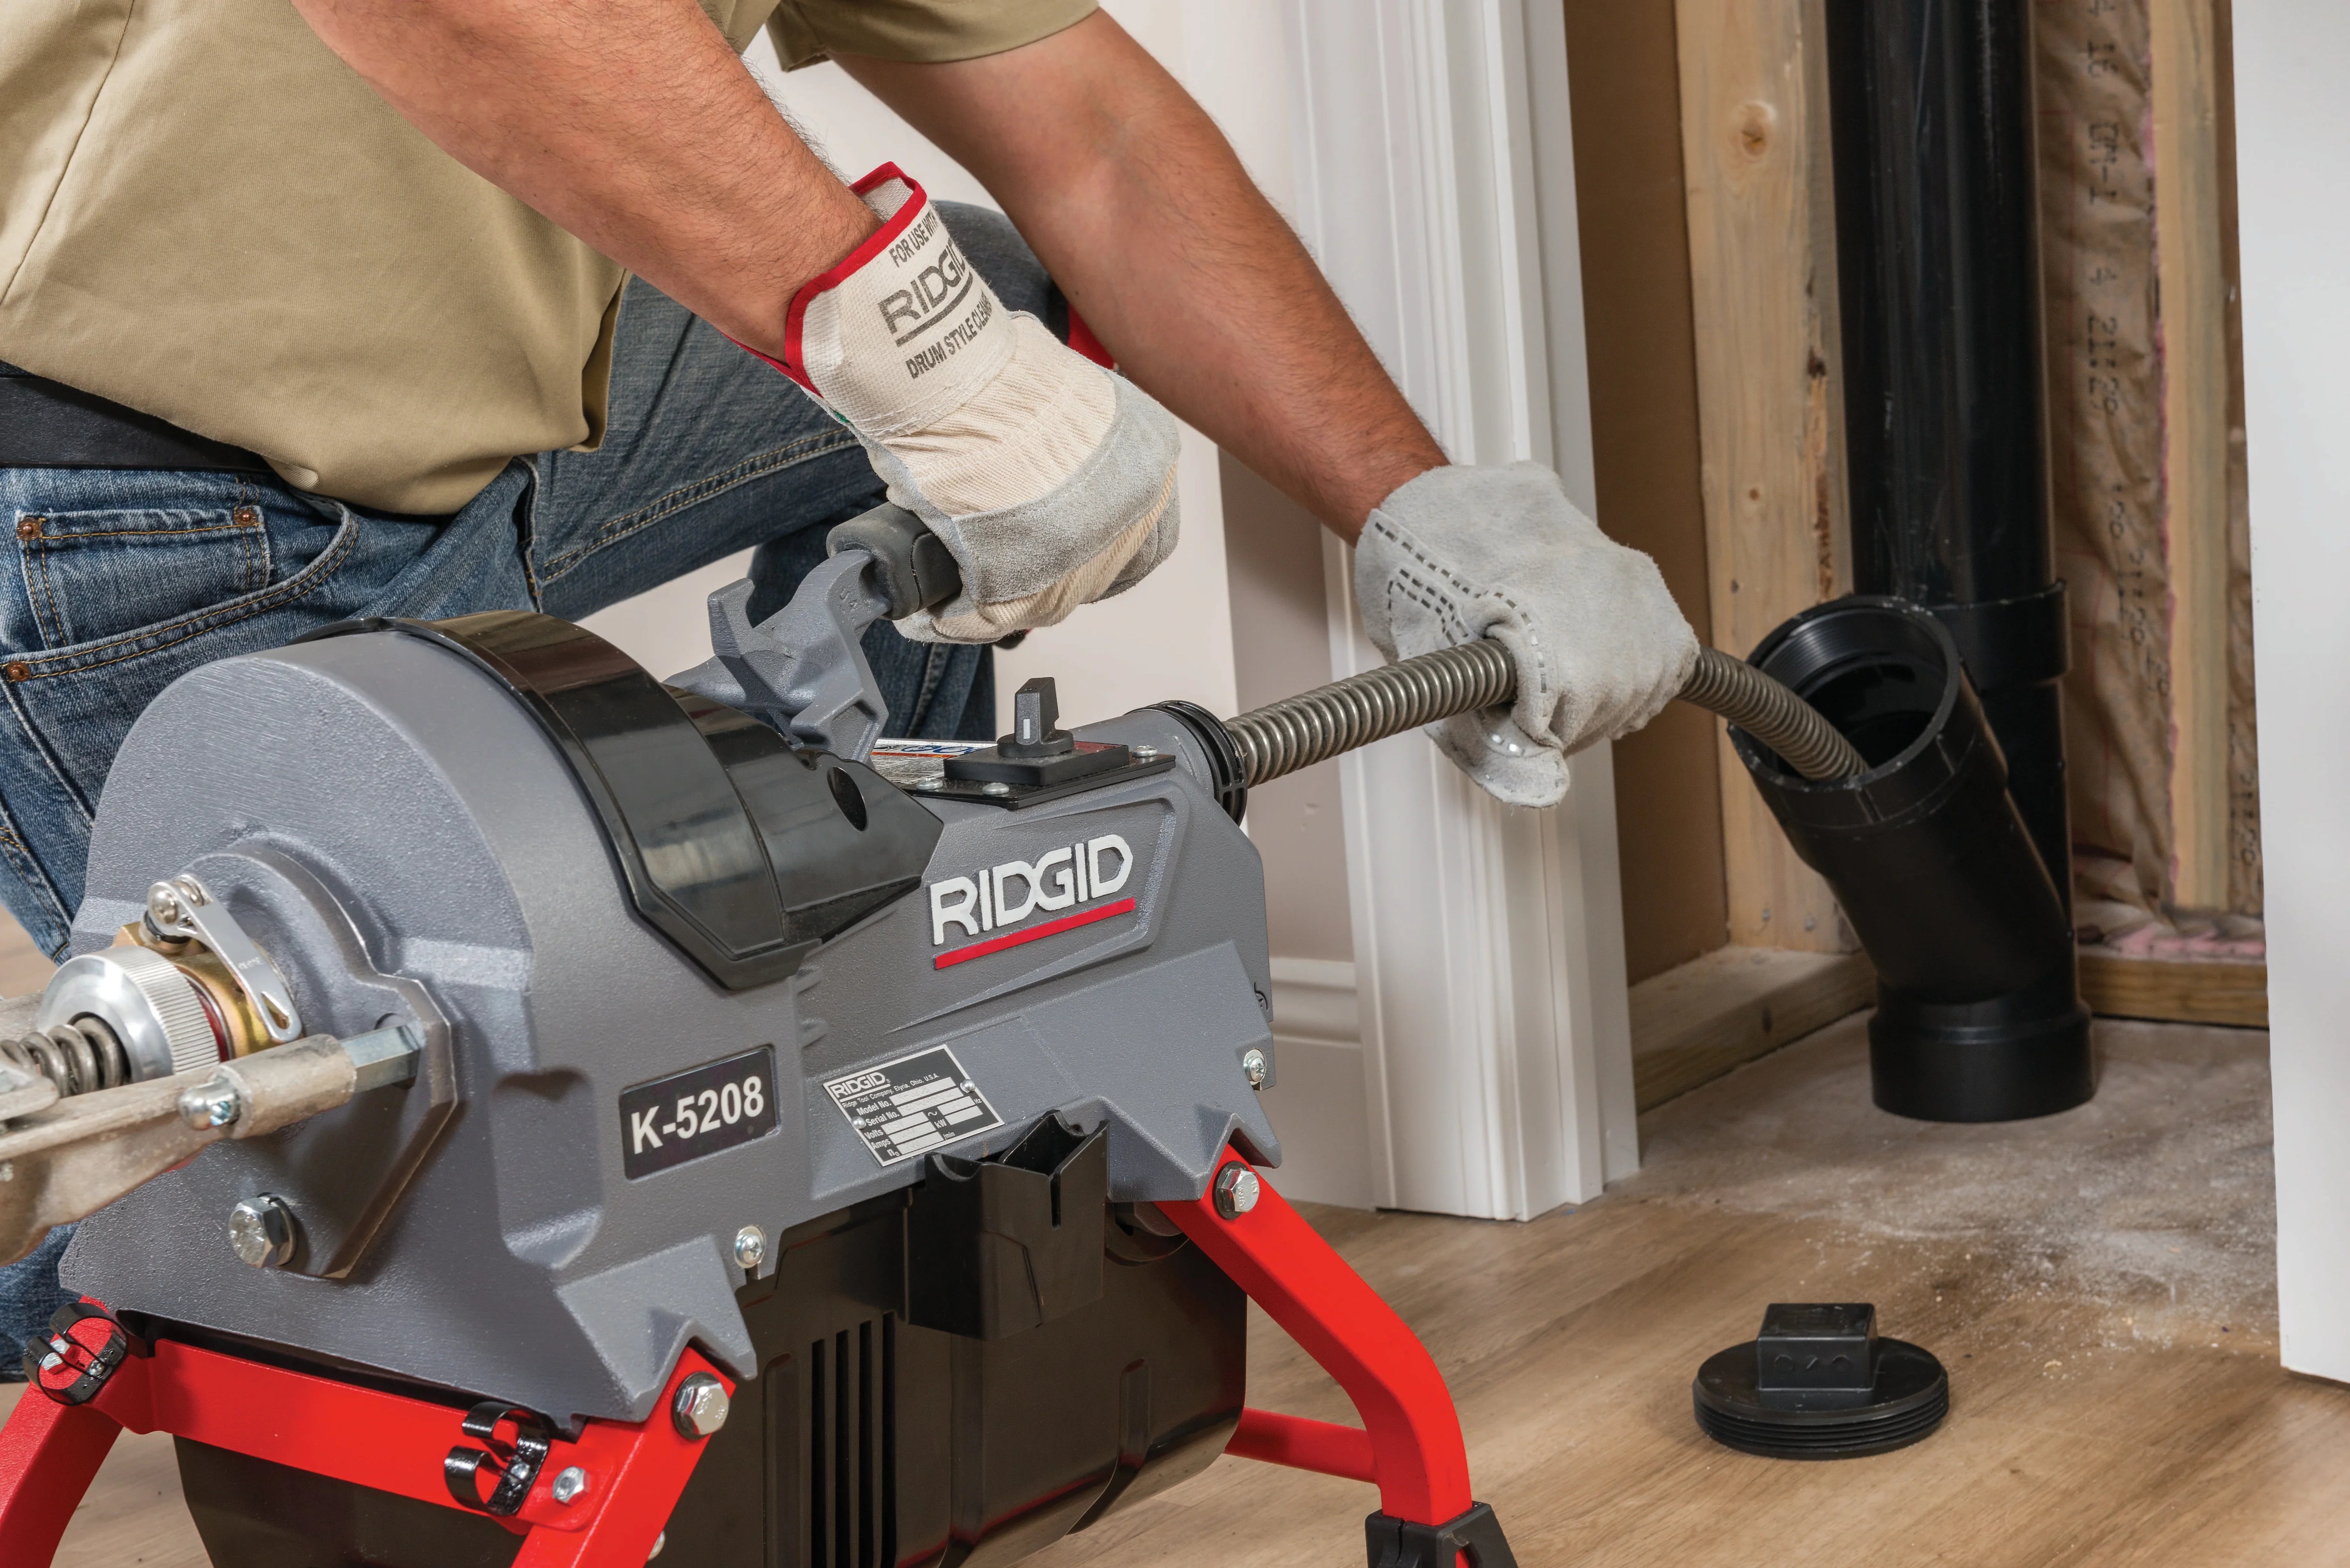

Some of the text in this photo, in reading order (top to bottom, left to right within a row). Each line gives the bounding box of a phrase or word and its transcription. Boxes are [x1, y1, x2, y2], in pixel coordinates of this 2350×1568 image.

[889, 209, 939, 268] FOR USE WITH
[905, 341, 948, 379] DRUM
[944, 317, 978, 355] STYLE
[930, 834, 1133, 946] RIDGID
[831, 1072, 885, 1097] RIDGID
[842, 1100, 857, 1108] Ridge
[869, 1088, 893, 1099] Company,
[894, 1083, 909, 1091] Elyria,
[631, 1076, 764, 1154] K-5208
[856, 1103, 878, 1115] Model
[878, 1099, 891, 1107] No.
[865, 1110, 899, 1125] Serial No.
[865, 1128, 883, 1139] Volts
[871, 1119, 947, 1149] Amps kW
